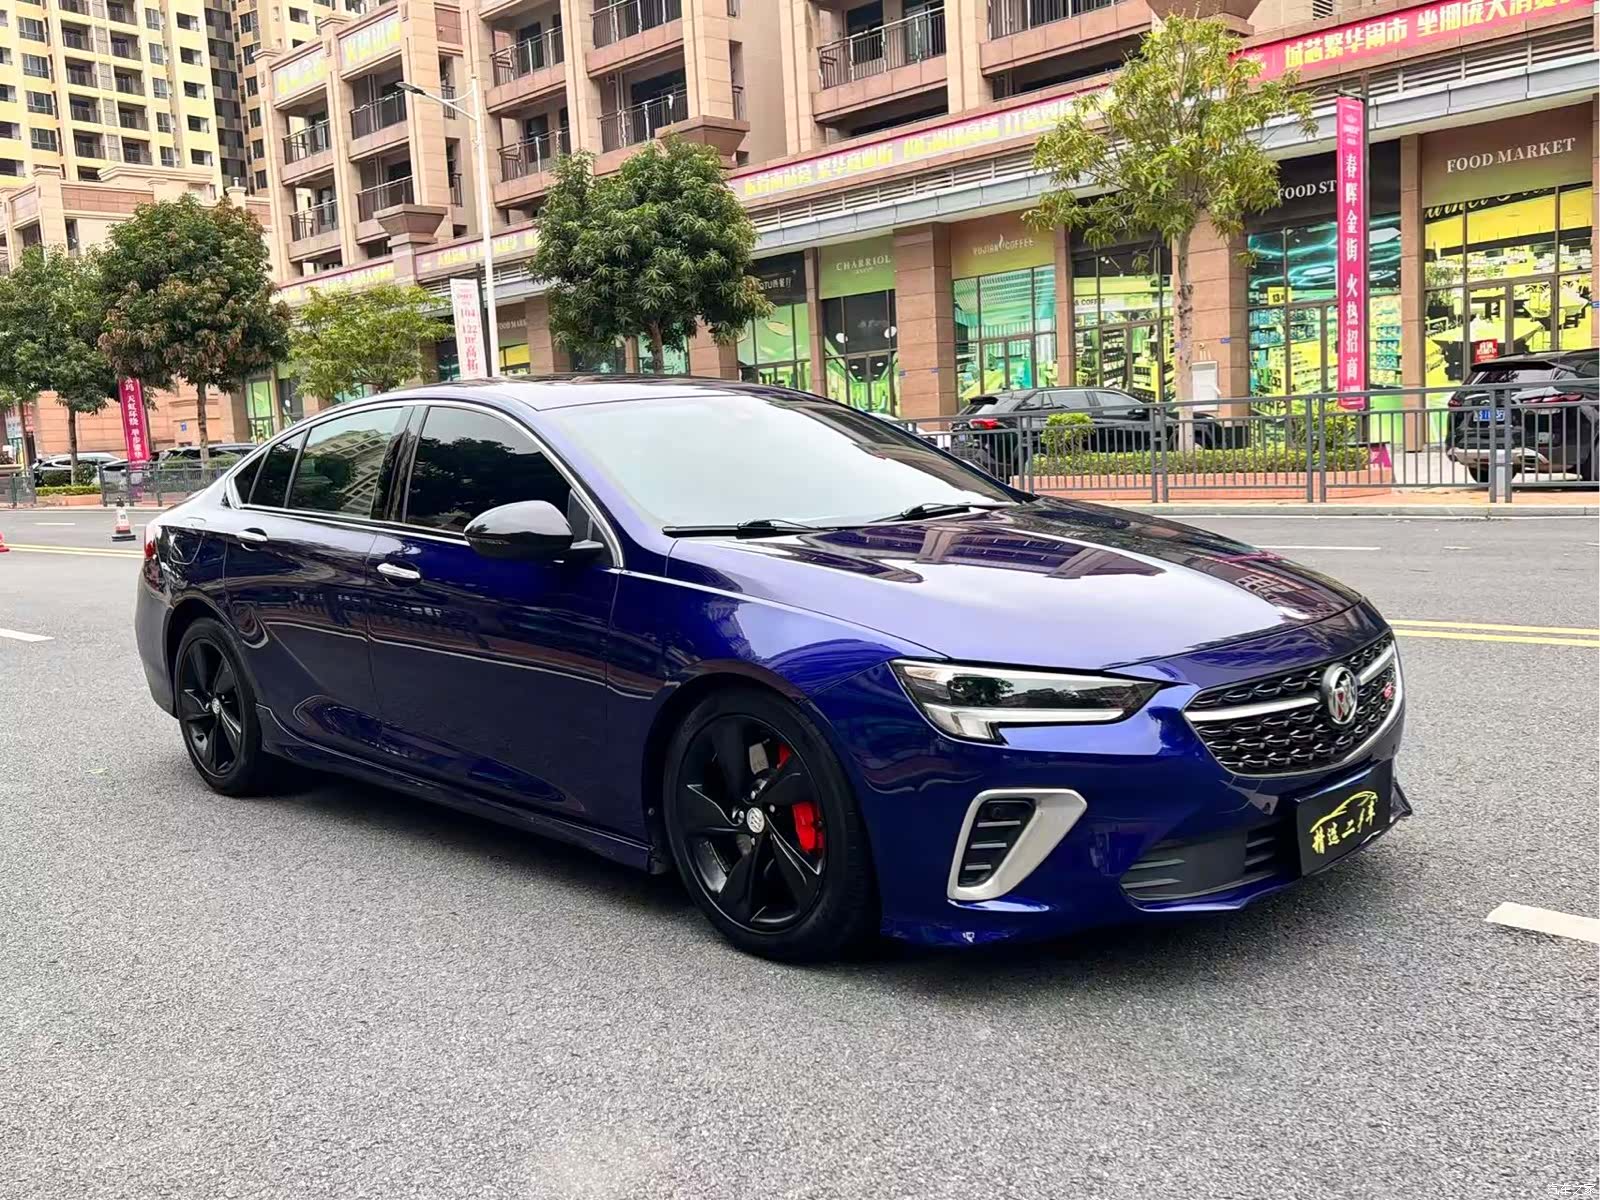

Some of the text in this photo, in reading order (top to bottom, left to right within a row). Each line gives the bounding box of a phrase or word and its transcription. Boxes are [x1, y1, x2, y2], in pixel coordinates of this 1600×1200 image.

[1284, 17, 1408, 68] 城芯繁华闹市
[1416, 0, 1571, 38] 坐拥庞大消
[1446, 137, 1576, 174] FOOD MARKET
[1277, 183, 1316, 200] FOOD
[836, 254, 891, 271] CHARRIOL
[1345, 273, 1359, 381] 火热招商
